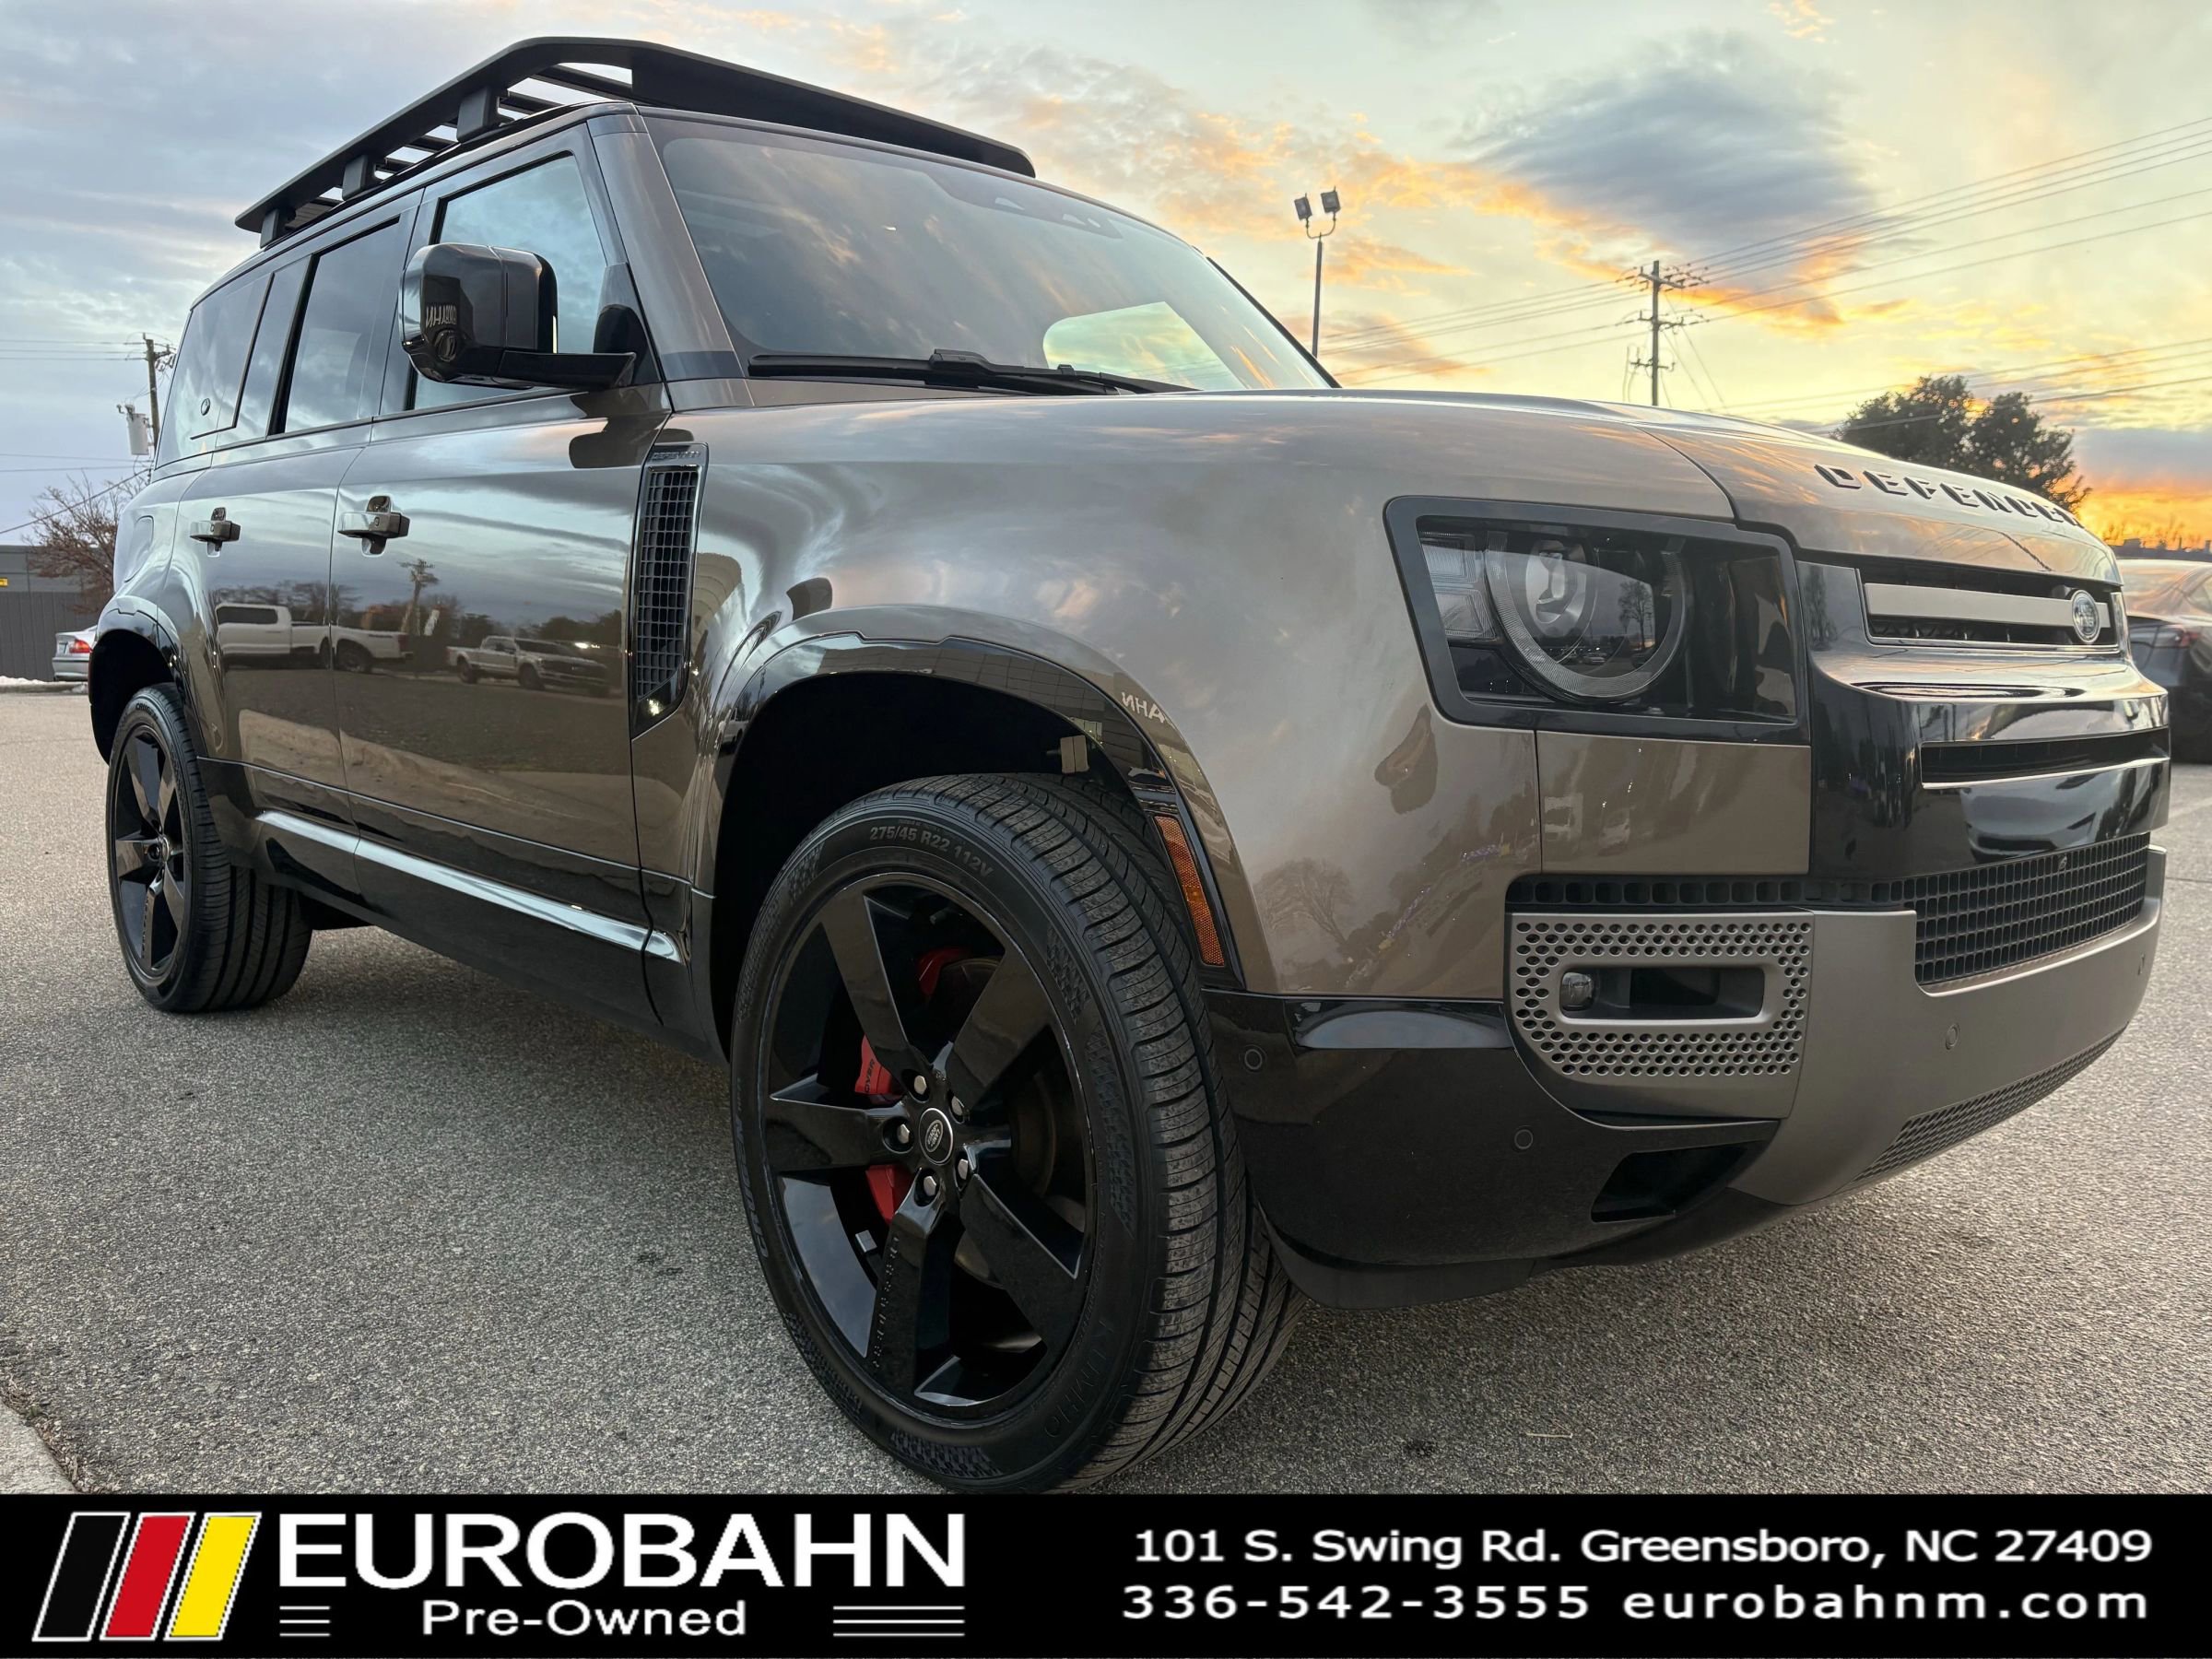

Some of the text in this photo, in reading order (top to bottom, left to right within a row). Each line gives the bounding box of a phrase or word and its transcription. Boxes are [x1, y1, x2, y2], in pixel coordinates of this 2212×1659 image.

[869, 824, 995, 877] 275/45 R22 112V
